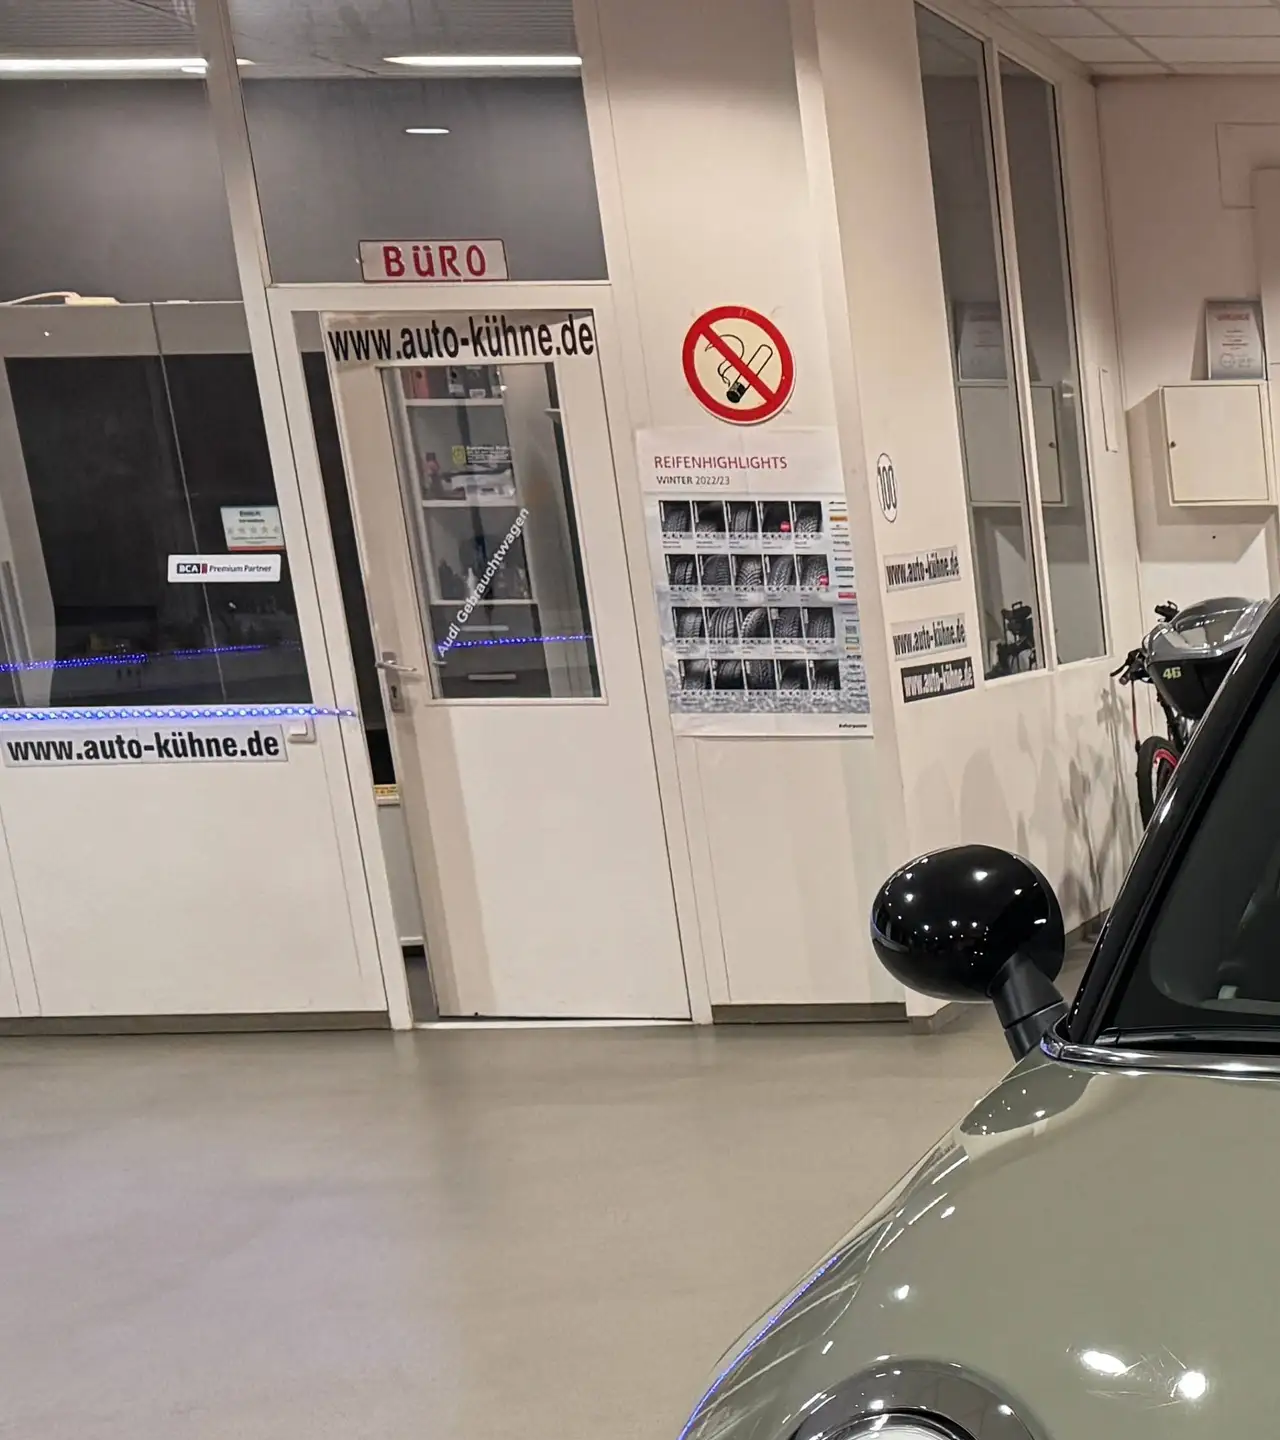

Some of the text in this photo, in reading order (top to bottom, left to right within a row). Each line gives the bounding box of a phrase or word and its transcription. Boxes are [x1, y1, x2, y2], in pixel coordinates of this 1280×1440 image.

[327, 314, 595, 361] www.auto-kühne.de
[654, 456, 788, 469] REIFENHIGHLIGHTS
[656, 475, 730, 485] WINTER 2022/23
[878, 466, 897, 511] 100
[178, 563, 271, 573] BCA Premium Partner
[437, 623, 460, 657] Audi
[456, 507, 529, 623] Gebrauchtwagen
[886, 550, 959, 586] www.auto-kühne.de
[893, 619, 965, 655] www.auto-kühne.de
[1163, 667, 1182, 679] 46
[7, 730, 280, 761] www.auto-kühne.de
